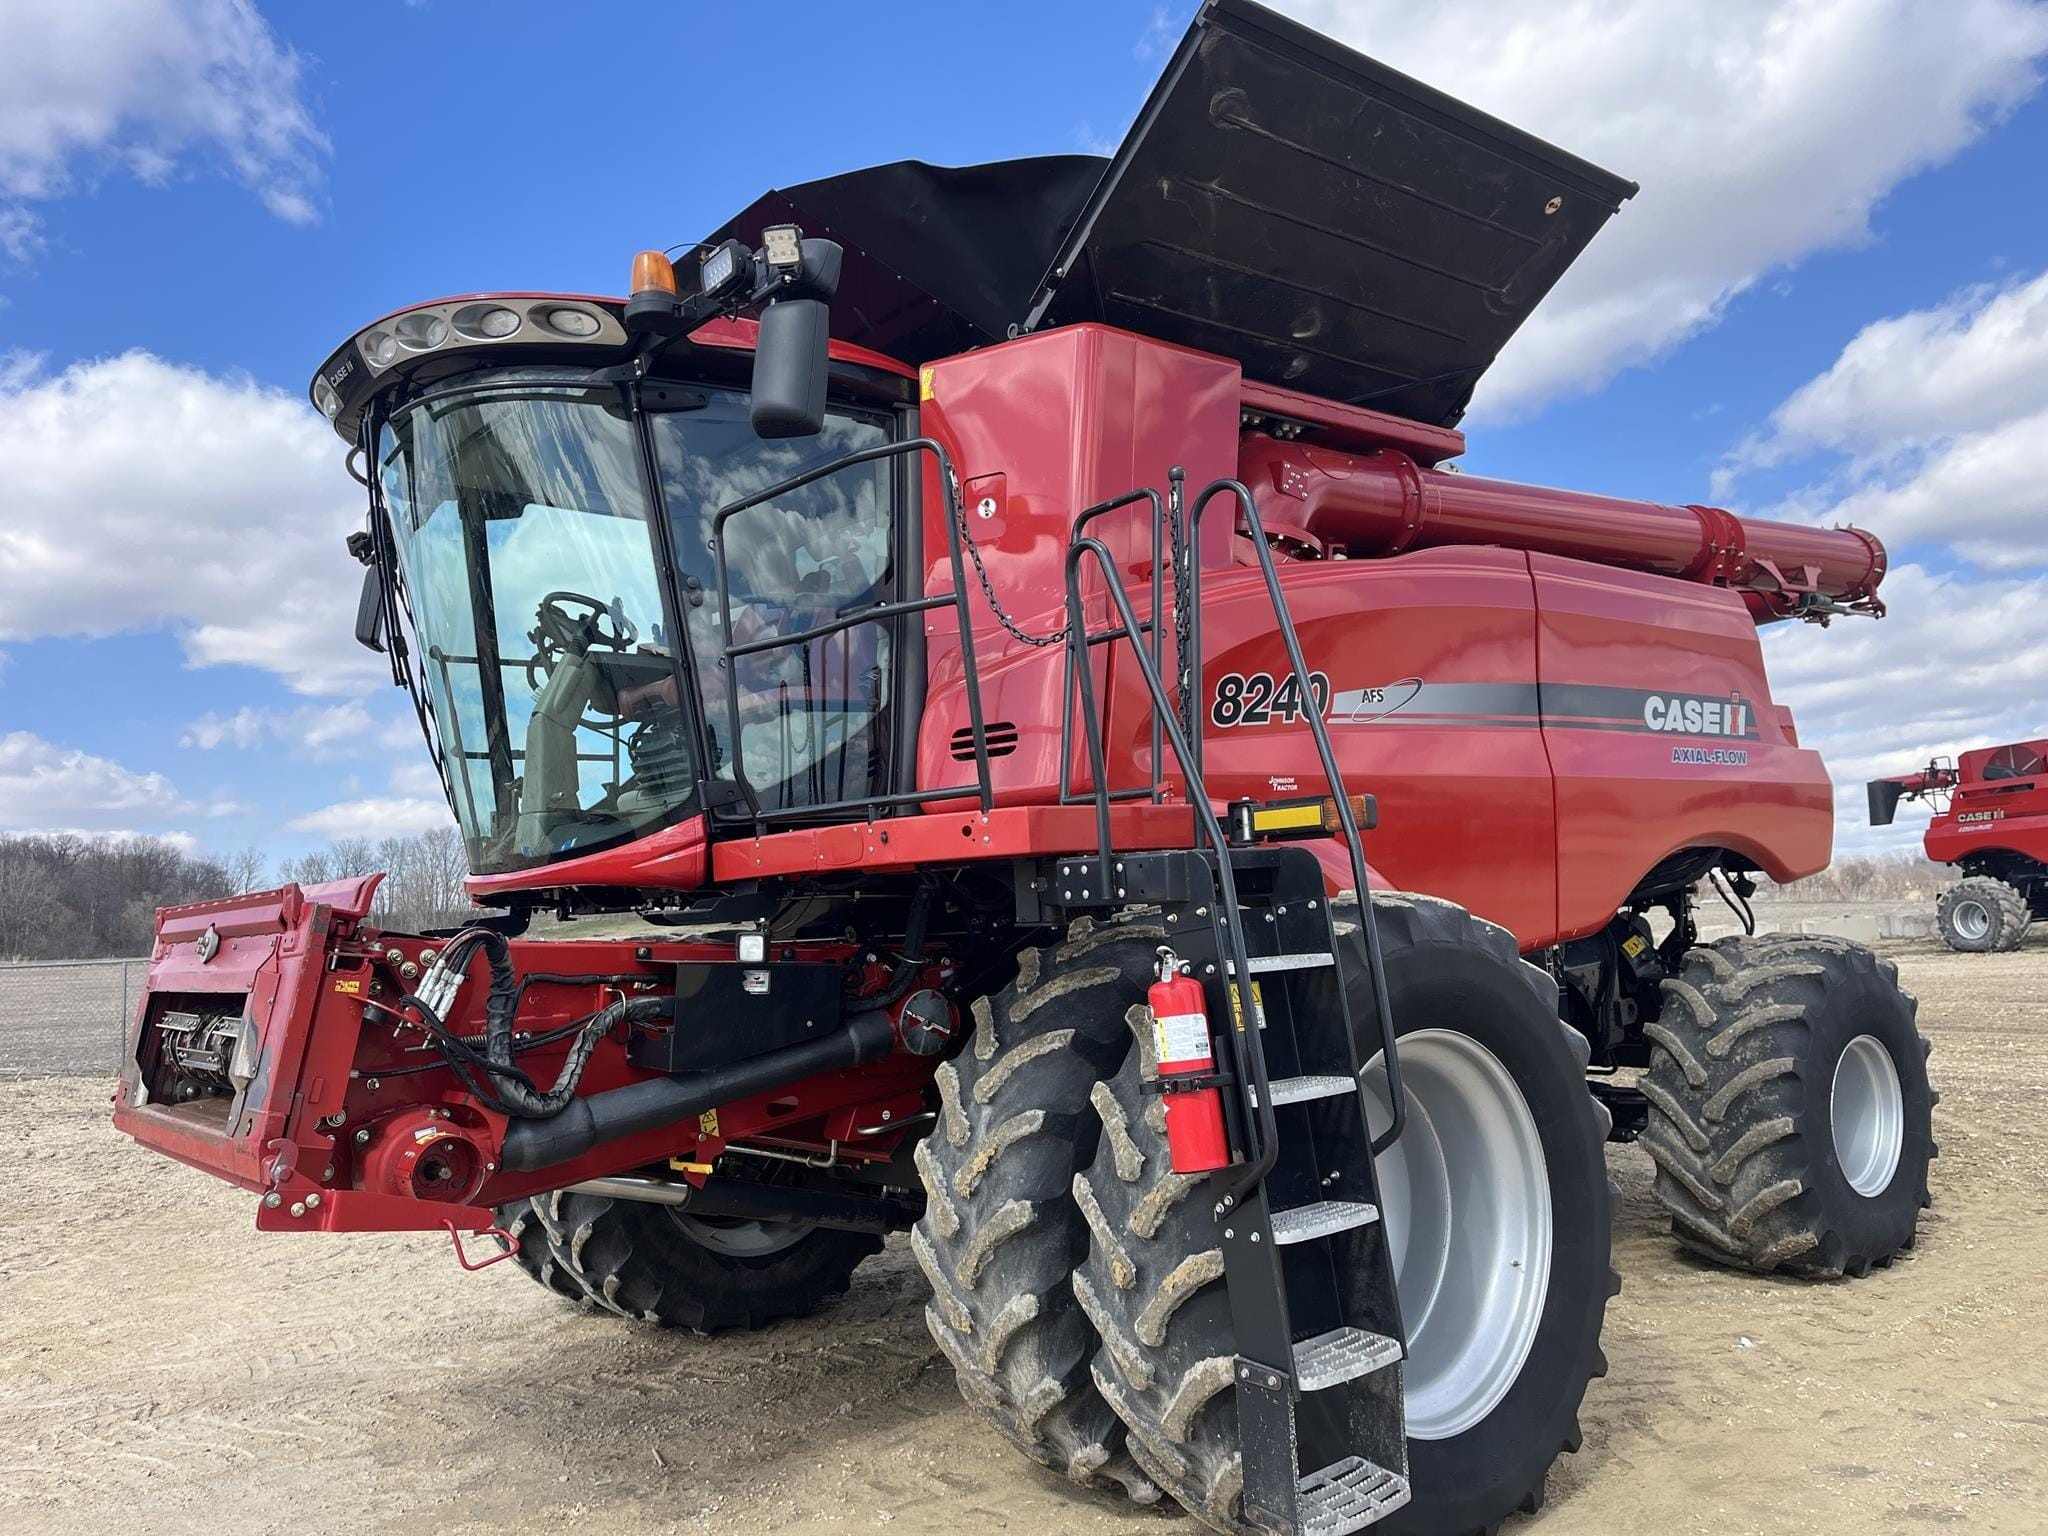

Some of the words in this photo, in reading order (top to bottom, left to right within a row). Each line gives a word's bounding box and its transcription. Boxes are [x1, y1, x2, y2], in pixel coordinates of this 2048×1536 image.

[330, 366, 349, 387] CASE
[1211, 671, 1330, 727] 8240
[1361, 688, 1384, 703] AFS
[1644, 695, 1721, 734] CASE
[1672, 747, 1747, 765] AXIAL-FLOW
[1957, 811, 1992, 822] CASE
